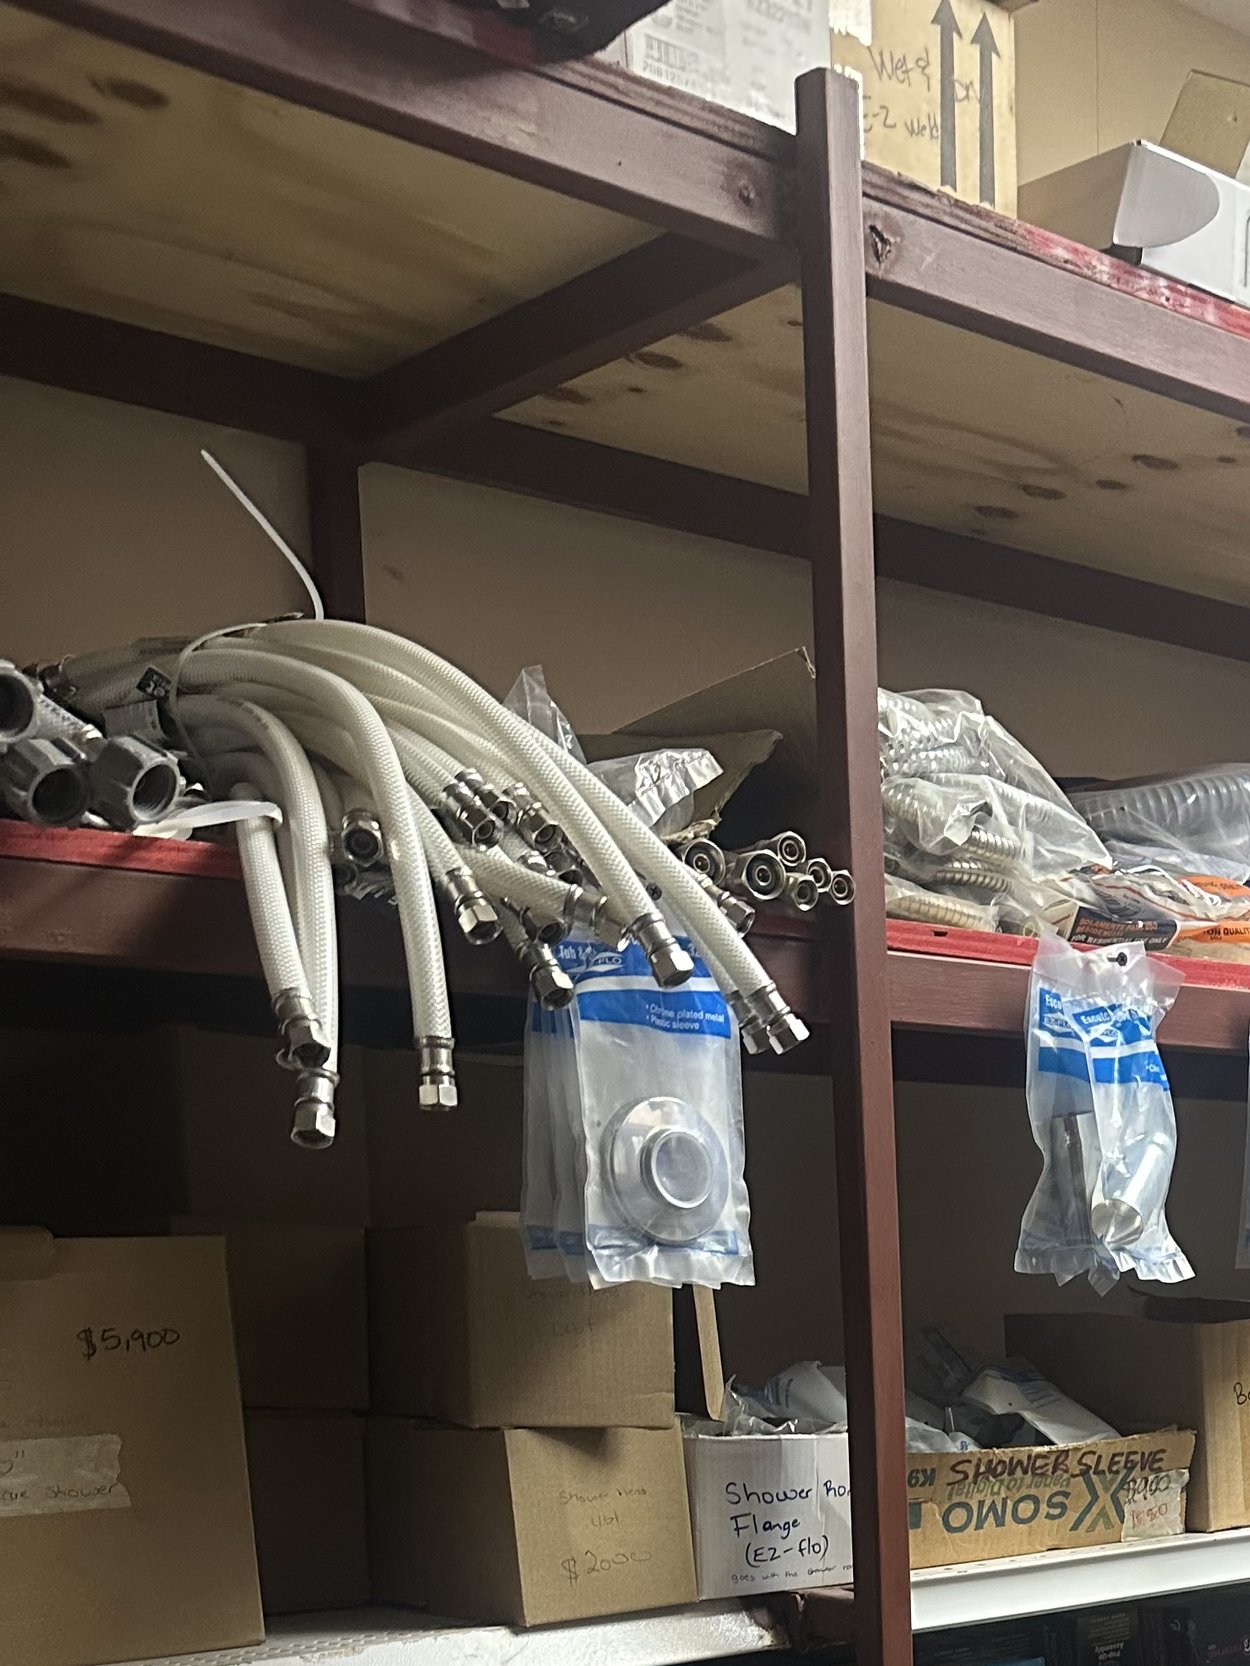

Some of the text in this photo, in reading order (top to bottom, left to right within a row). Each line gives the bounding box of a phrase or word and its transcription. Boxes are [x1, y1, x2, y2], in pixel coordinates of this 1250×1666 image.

[672, 1018, 700, 1030] sleeve
[677, 1009, 725, 1023] plated metal
[76, 1327, 181, 1361] $5,900
[947, 1448, 1167, 1486] SHOWER SLEEVE
[726, 1482, 813, 1505] Shower
[730, 1513, 801, 1539] Flange
